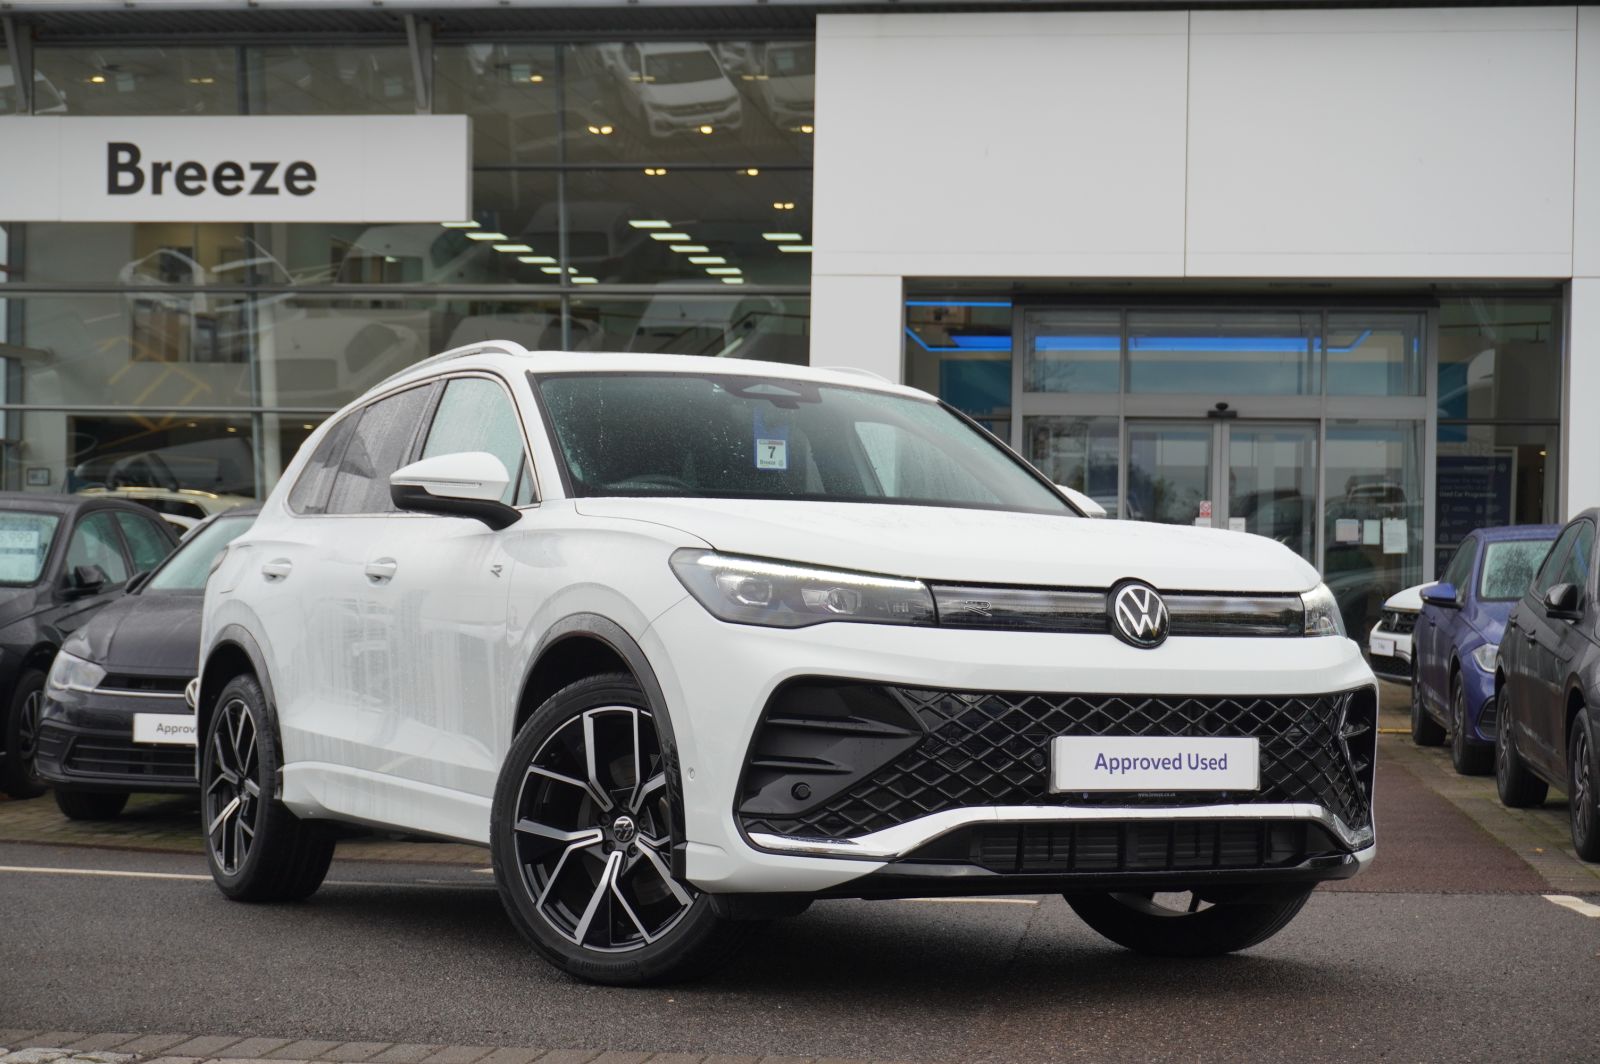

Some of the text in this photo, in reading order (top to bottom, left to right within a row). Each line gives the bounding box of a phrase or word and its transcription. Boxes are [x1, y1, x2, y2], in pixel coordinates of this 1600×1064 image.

[107, 141, 317, 196] Breeze
[767, 446, 776, 459] 7
[1094, 752, 1228, 775] Approved Used
